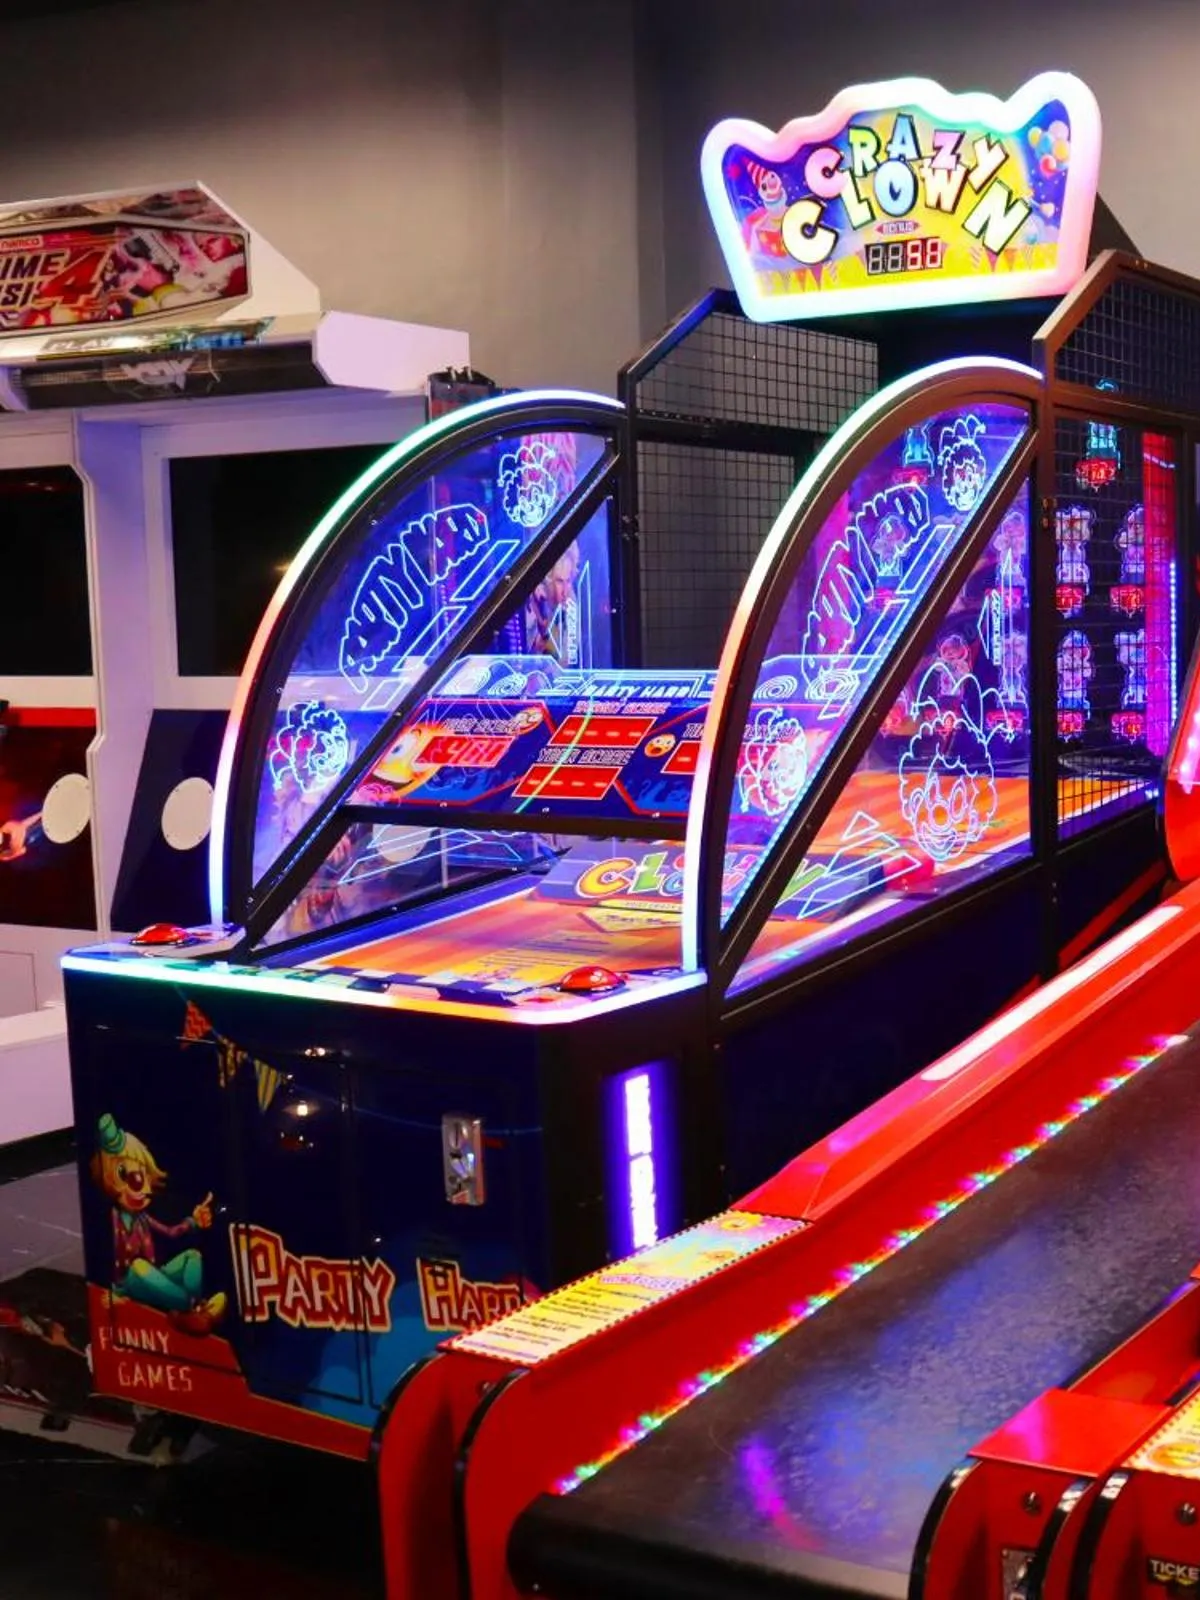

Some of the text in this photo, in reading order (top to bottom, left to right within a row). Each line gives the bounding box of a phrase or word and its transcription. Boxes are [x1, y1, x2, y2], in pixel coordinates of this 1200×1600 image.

[804, 113, 1009, 198] CRAZY
[781, 157, 1032, 265] CLOWN
[228, 1222, 396, 1332] PARTY
[101, 1325, 171, 1356] FUNNY
[117, 1361, 194, 1393] GAMES
[1150, 1558, 1199, 1580] TICKE
